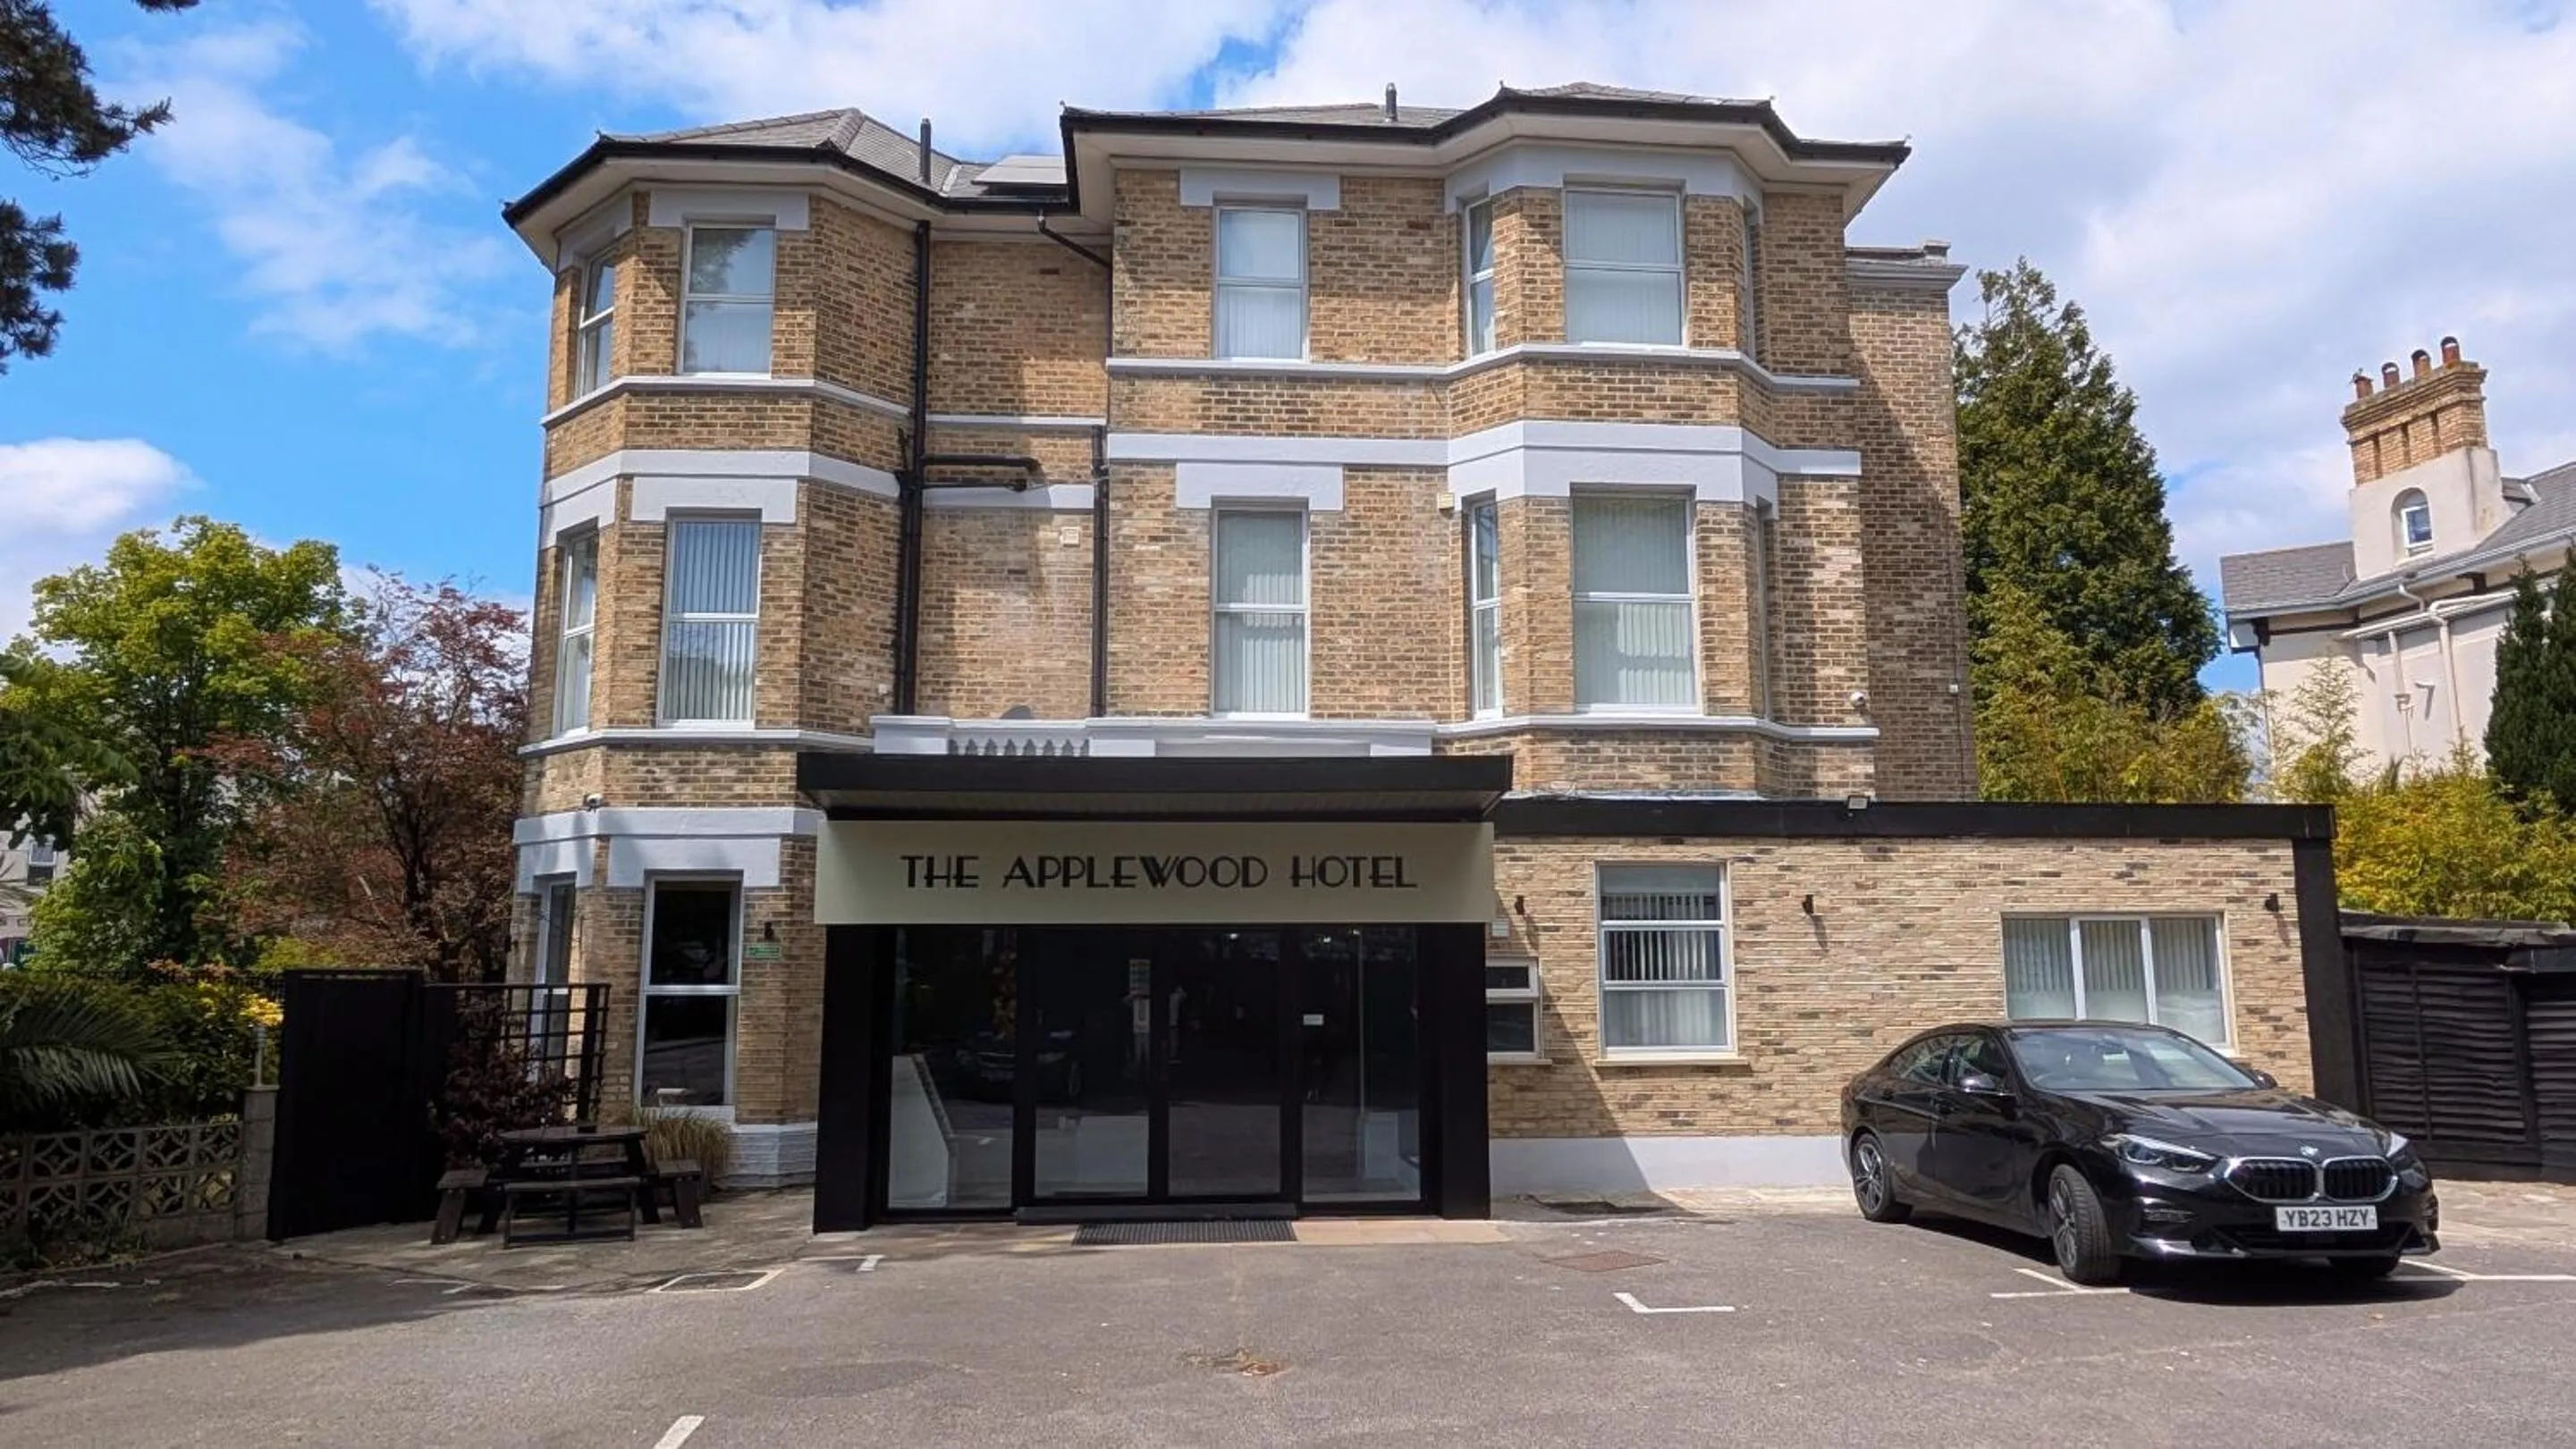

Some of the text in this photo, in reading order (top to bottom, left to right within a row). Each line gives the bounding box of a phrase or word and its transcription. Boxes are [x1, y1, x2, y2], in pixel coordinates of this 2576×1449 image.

[900, 855, 1418, 888] THE APPLEWOOD HOTEL
[2285, 1209, 2369, 1226] YB23 HZY
